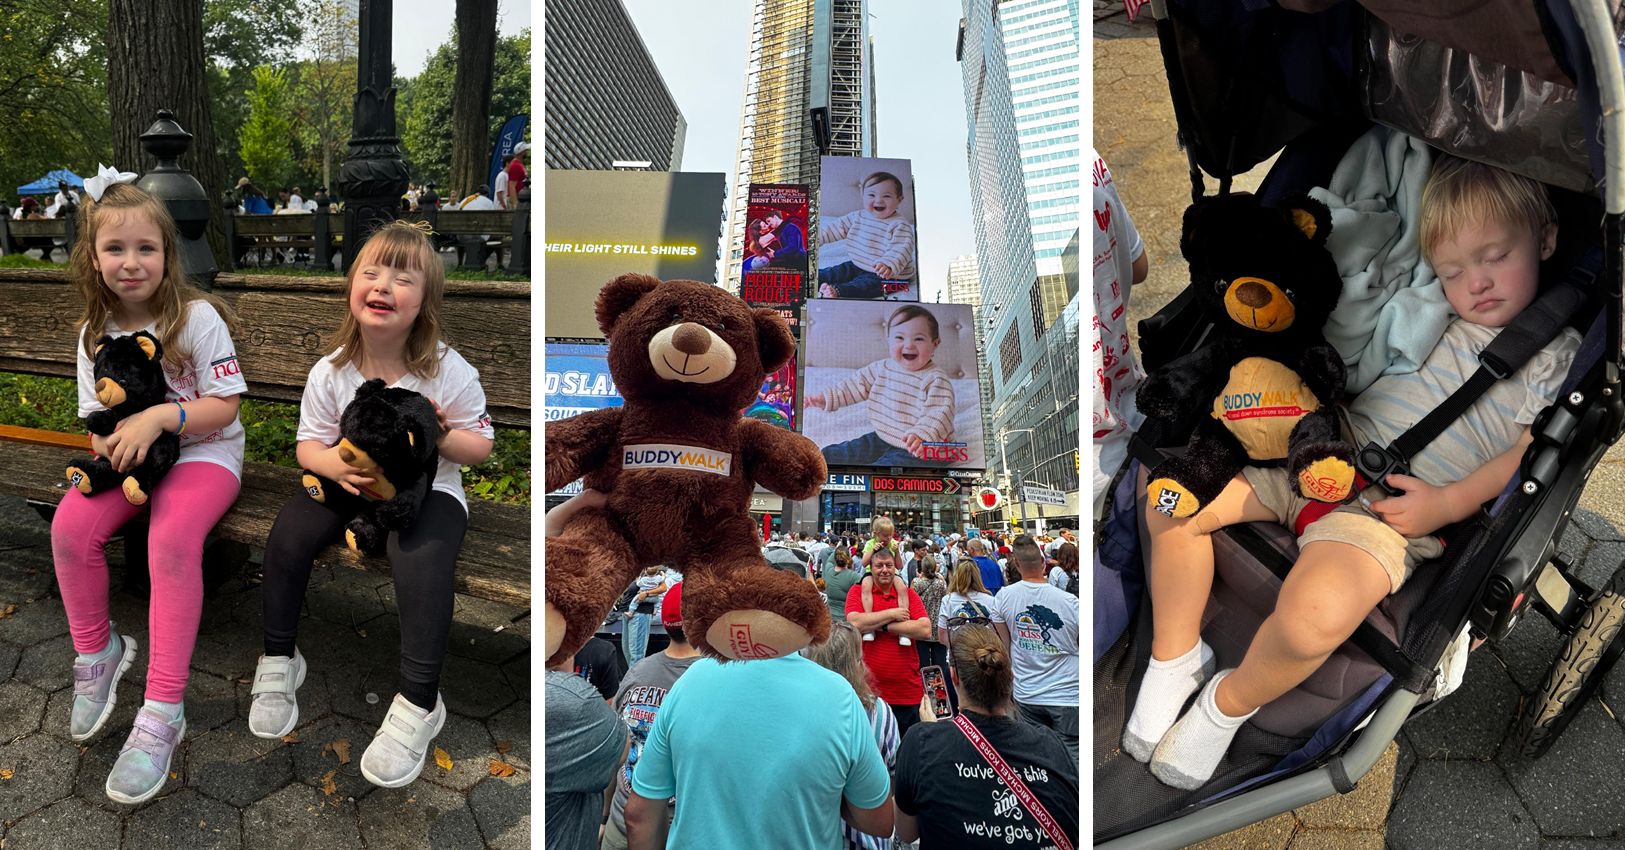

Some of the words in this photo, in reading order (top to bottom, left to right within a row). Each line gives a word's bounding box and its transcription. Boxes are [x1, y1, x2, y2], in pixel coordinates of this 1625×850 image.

[502, 131, 513, 156] REA
[574, 243, 613, 254] LIGHT
[613, 244, 648, 255] STILL
[650, 245, 698, 256] SHINES
[745, 273, 793, 289] MOULIN
[545, 371, 618, 396] DSLA
[624, 450, 725, 471] BUDDYWALK
[843, 475, 865, 485] FIN
[873, 478, 895, 490] DOS
[897, 479, 943, 492] CAMINOS
[622, 686, 667, 708] OCEAN
[979, 742, 1000, 766] KORS
[955, 763, 995, 780] You've
[1023, 765, 1048, 783] this
[1000, 765, 1032, 803] MICHAEL
[993, 790, 1021, 819] and
[1030, 802, 1052, 828] KORS
[963, 821, 1002, 838] we've
[1004, 824, 1034, 844] got
